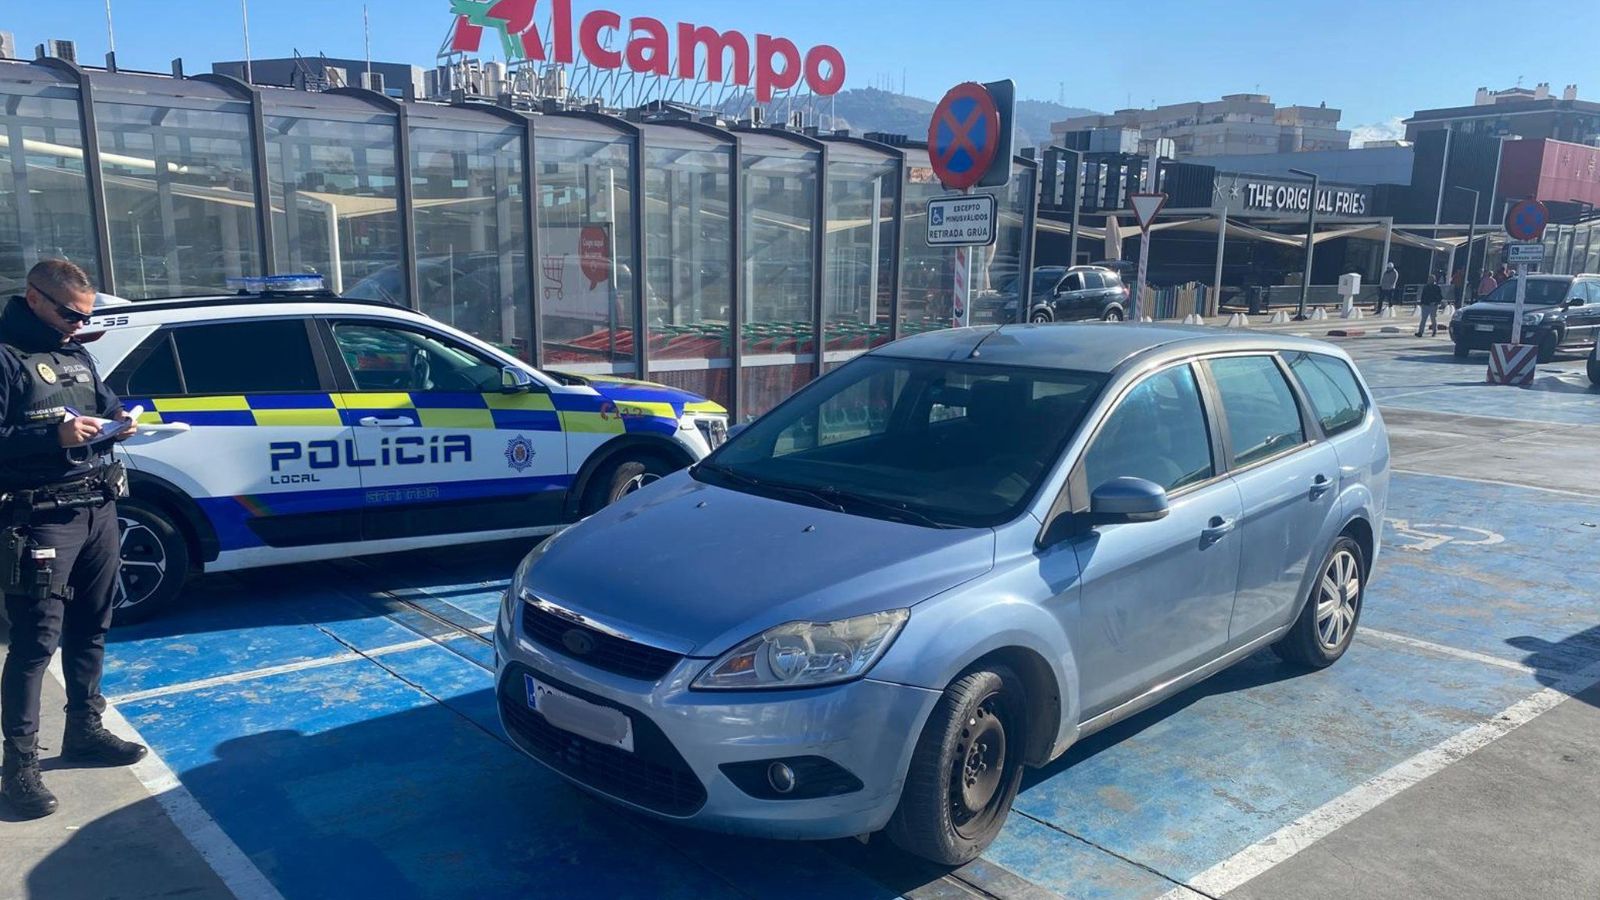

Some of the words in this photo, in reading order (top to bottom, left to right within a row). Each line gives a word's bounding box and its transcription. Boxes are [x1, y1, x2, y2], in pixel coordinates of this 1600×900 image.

[451, 0, 846, 103] Alcampo
[1248, 183, 1274, 208] THE
[1335, 191, 1367, 214] FRIES
[953, 203, 981, 212] EXCEPTO
[929, 229, 964, 238] RETIRADA
[270, 473, 320, 485] LOCAL
